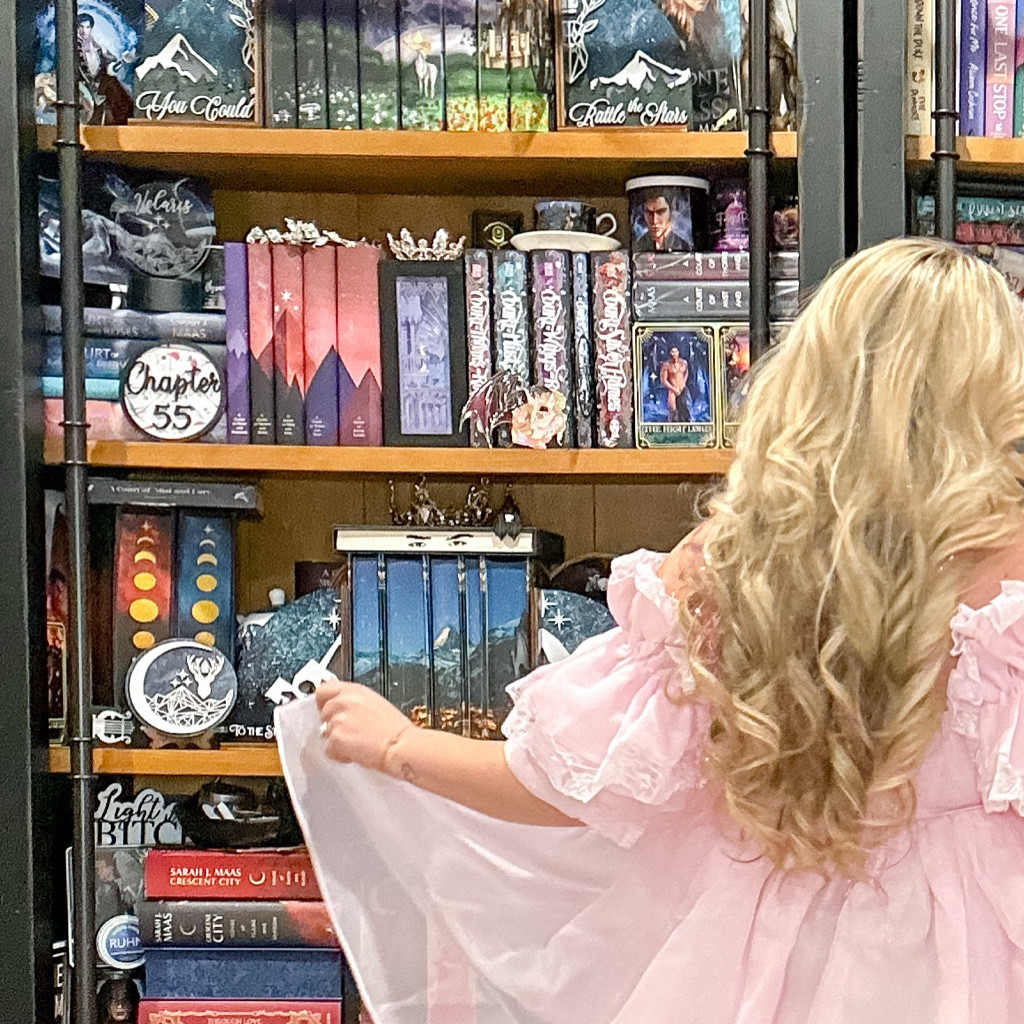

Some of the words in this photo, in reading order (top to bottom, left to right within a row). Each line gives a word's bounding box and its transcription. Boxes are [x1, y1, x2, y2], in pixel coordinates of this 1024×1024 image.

[994, 5, 1009, 36] ONE
[994, 42, 1008, 82] LAST
[135, 91, 187, 120] You
[190, 97, 253, 120] Could
[569, 101, 625, 128] Rattle
[627, 98, 643, 114] the
[643, 100, 688, 127] Stars
[993, 84, 1006, 120] STOP
[134, 188, 193, 216] Velaris
[695, 287, 703, 312] COURT
[709, 294, 716, 305] OF
[125, 361, 221, 402] Chapter
[152, 404, 192, 430] 55
[100, 789, 160, 822] Light
[169, 877, 216, 886] CRESCENT
[219, 877, 241, 886] CITY
[170, 867, 201, 877] SARAH
[205, 868, 212, 877] J.
[214, 868, 242, 877] MAAS
[163, 912, 173, 942] MAAS
[214, 914, 224, 943] CITY
